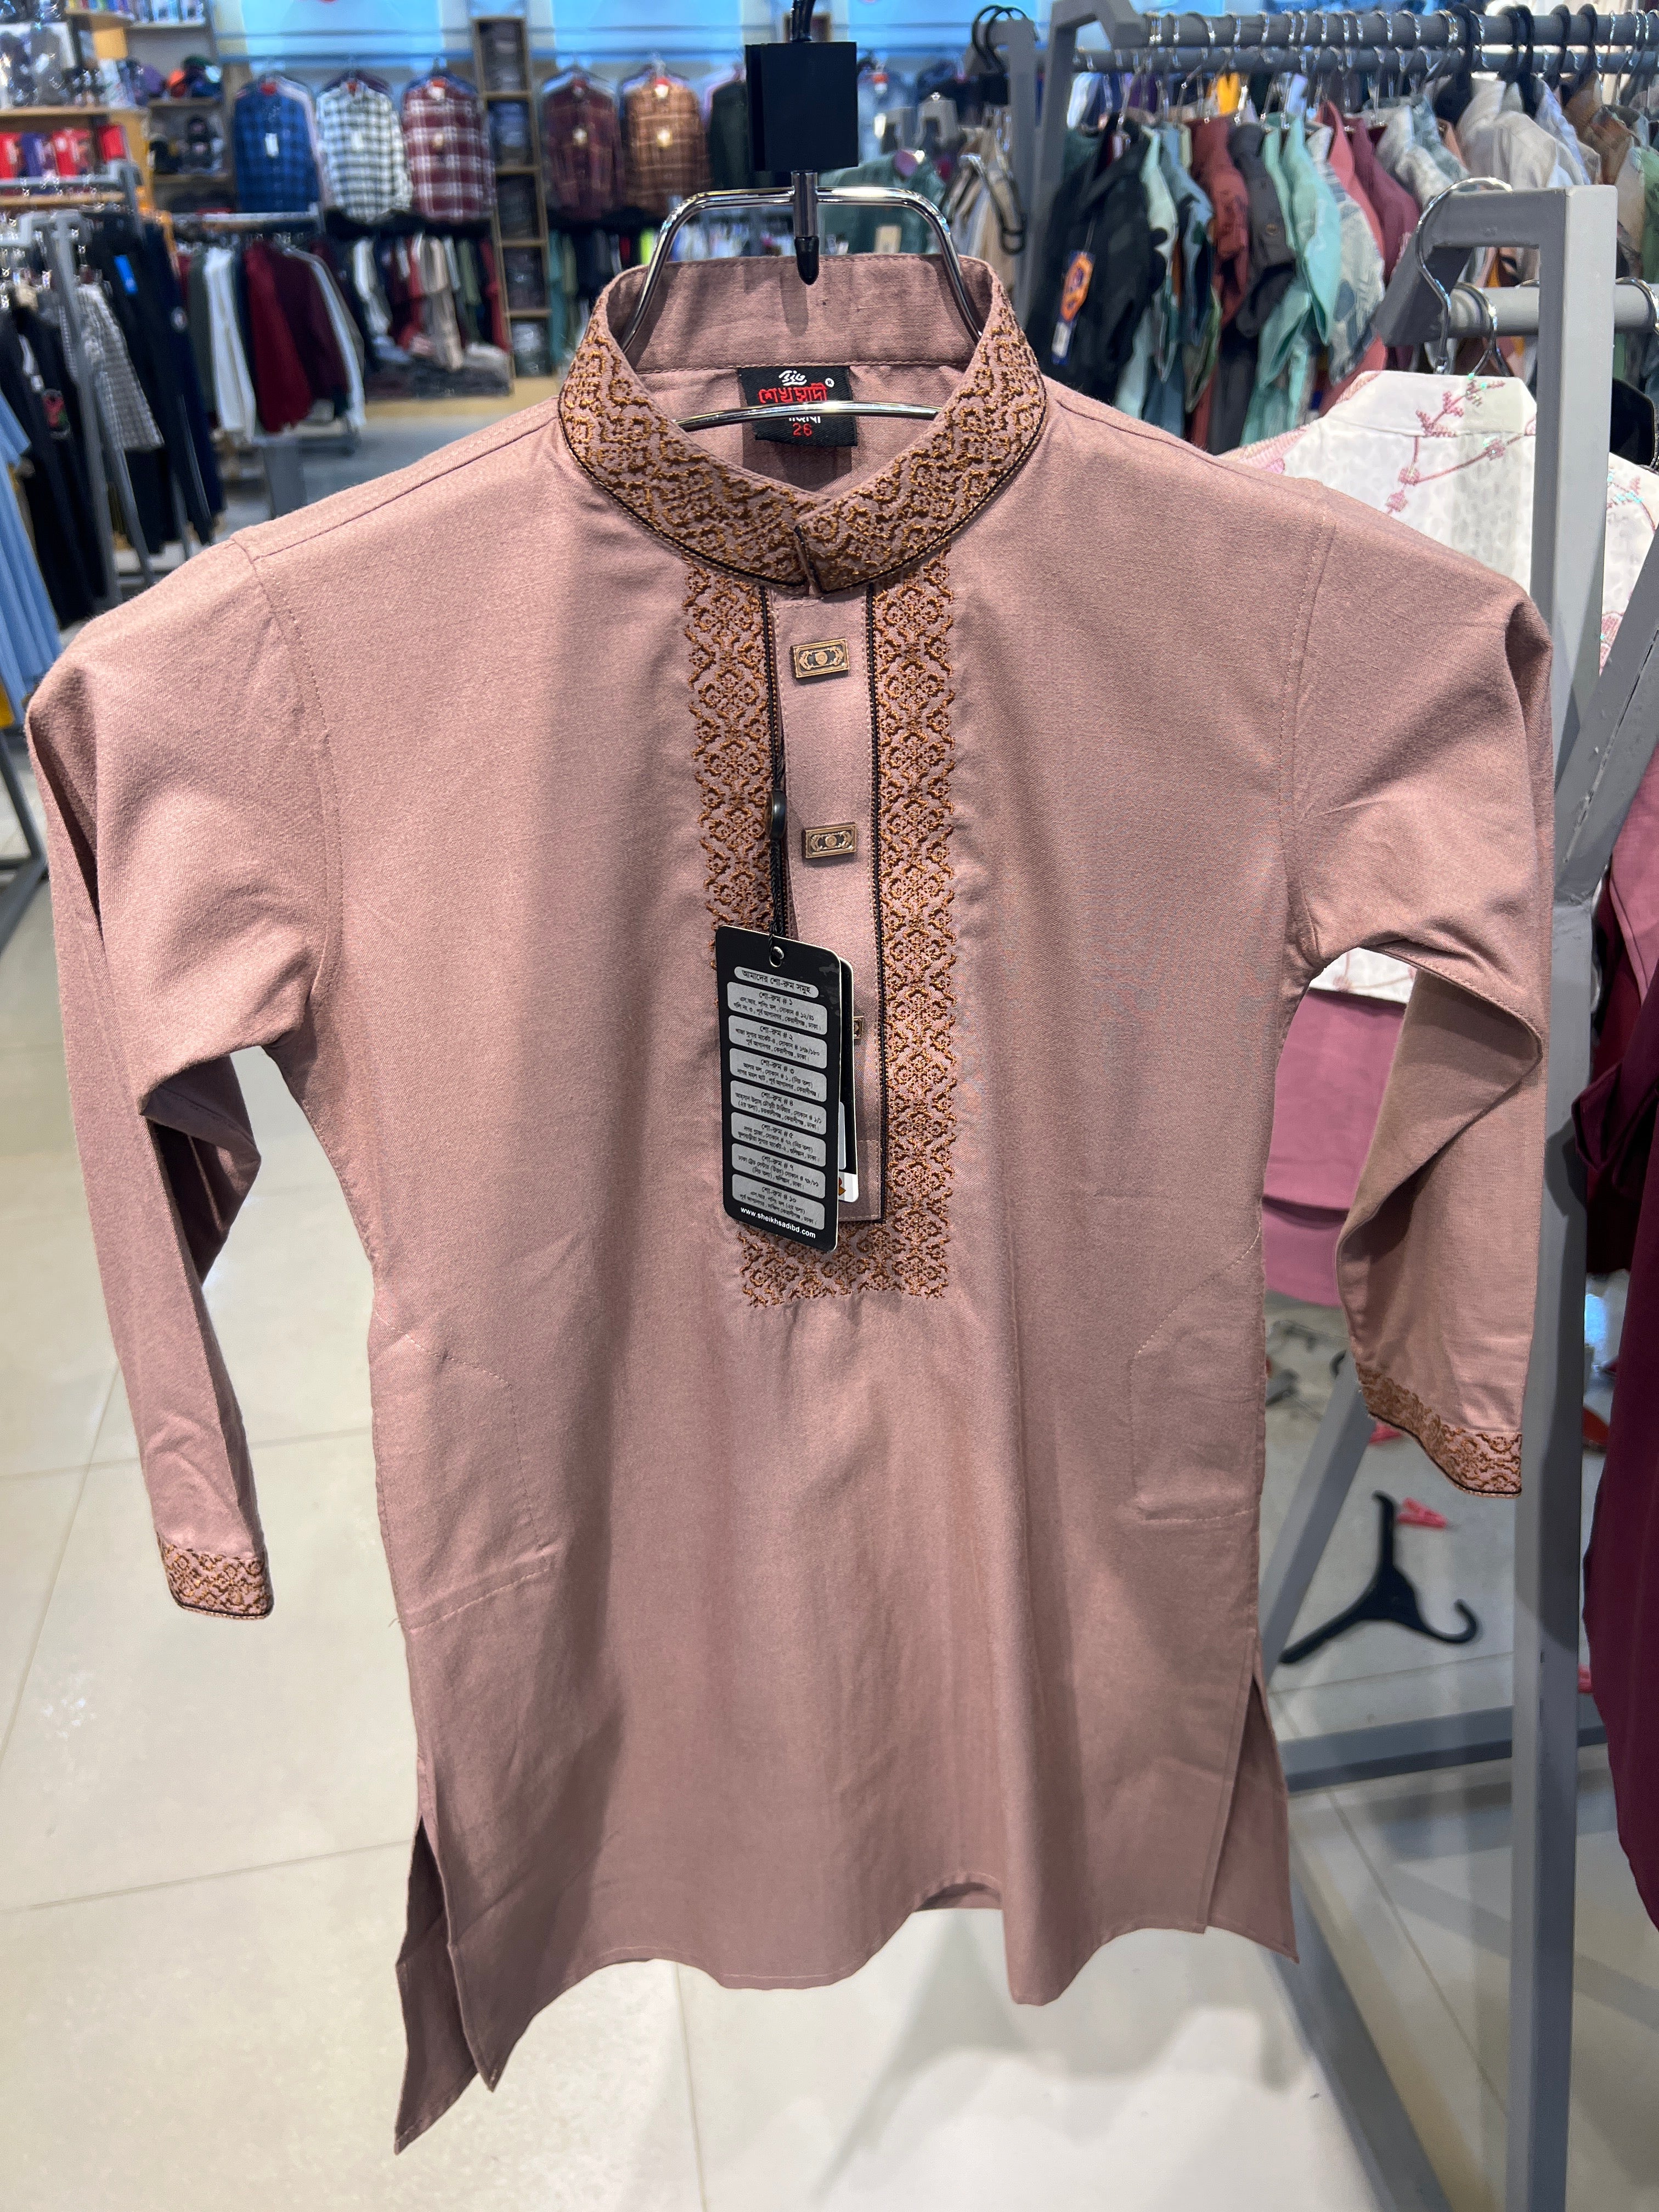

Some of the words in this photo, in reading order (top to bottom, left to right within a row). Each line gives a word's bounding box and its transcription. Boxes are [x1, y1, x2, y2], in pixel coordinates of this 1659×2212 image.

[793, 423, 812, 437] 26
[742, 970, 768, 982] আমাদের
[770, 978, 794, 989] শো-রুম
[759, 992, 781, 1002] শো-রুম
[760, 1026, 781, 1036] শো-রুম
[760, 1059, 782, 1070] শো-রুম
[761, 1092, 781, 1102] শো-রুম
[761, 1124, 782, 1135] শো-রুম
[741, 1207, 815, 1238] www.sheikhsadibd.com
